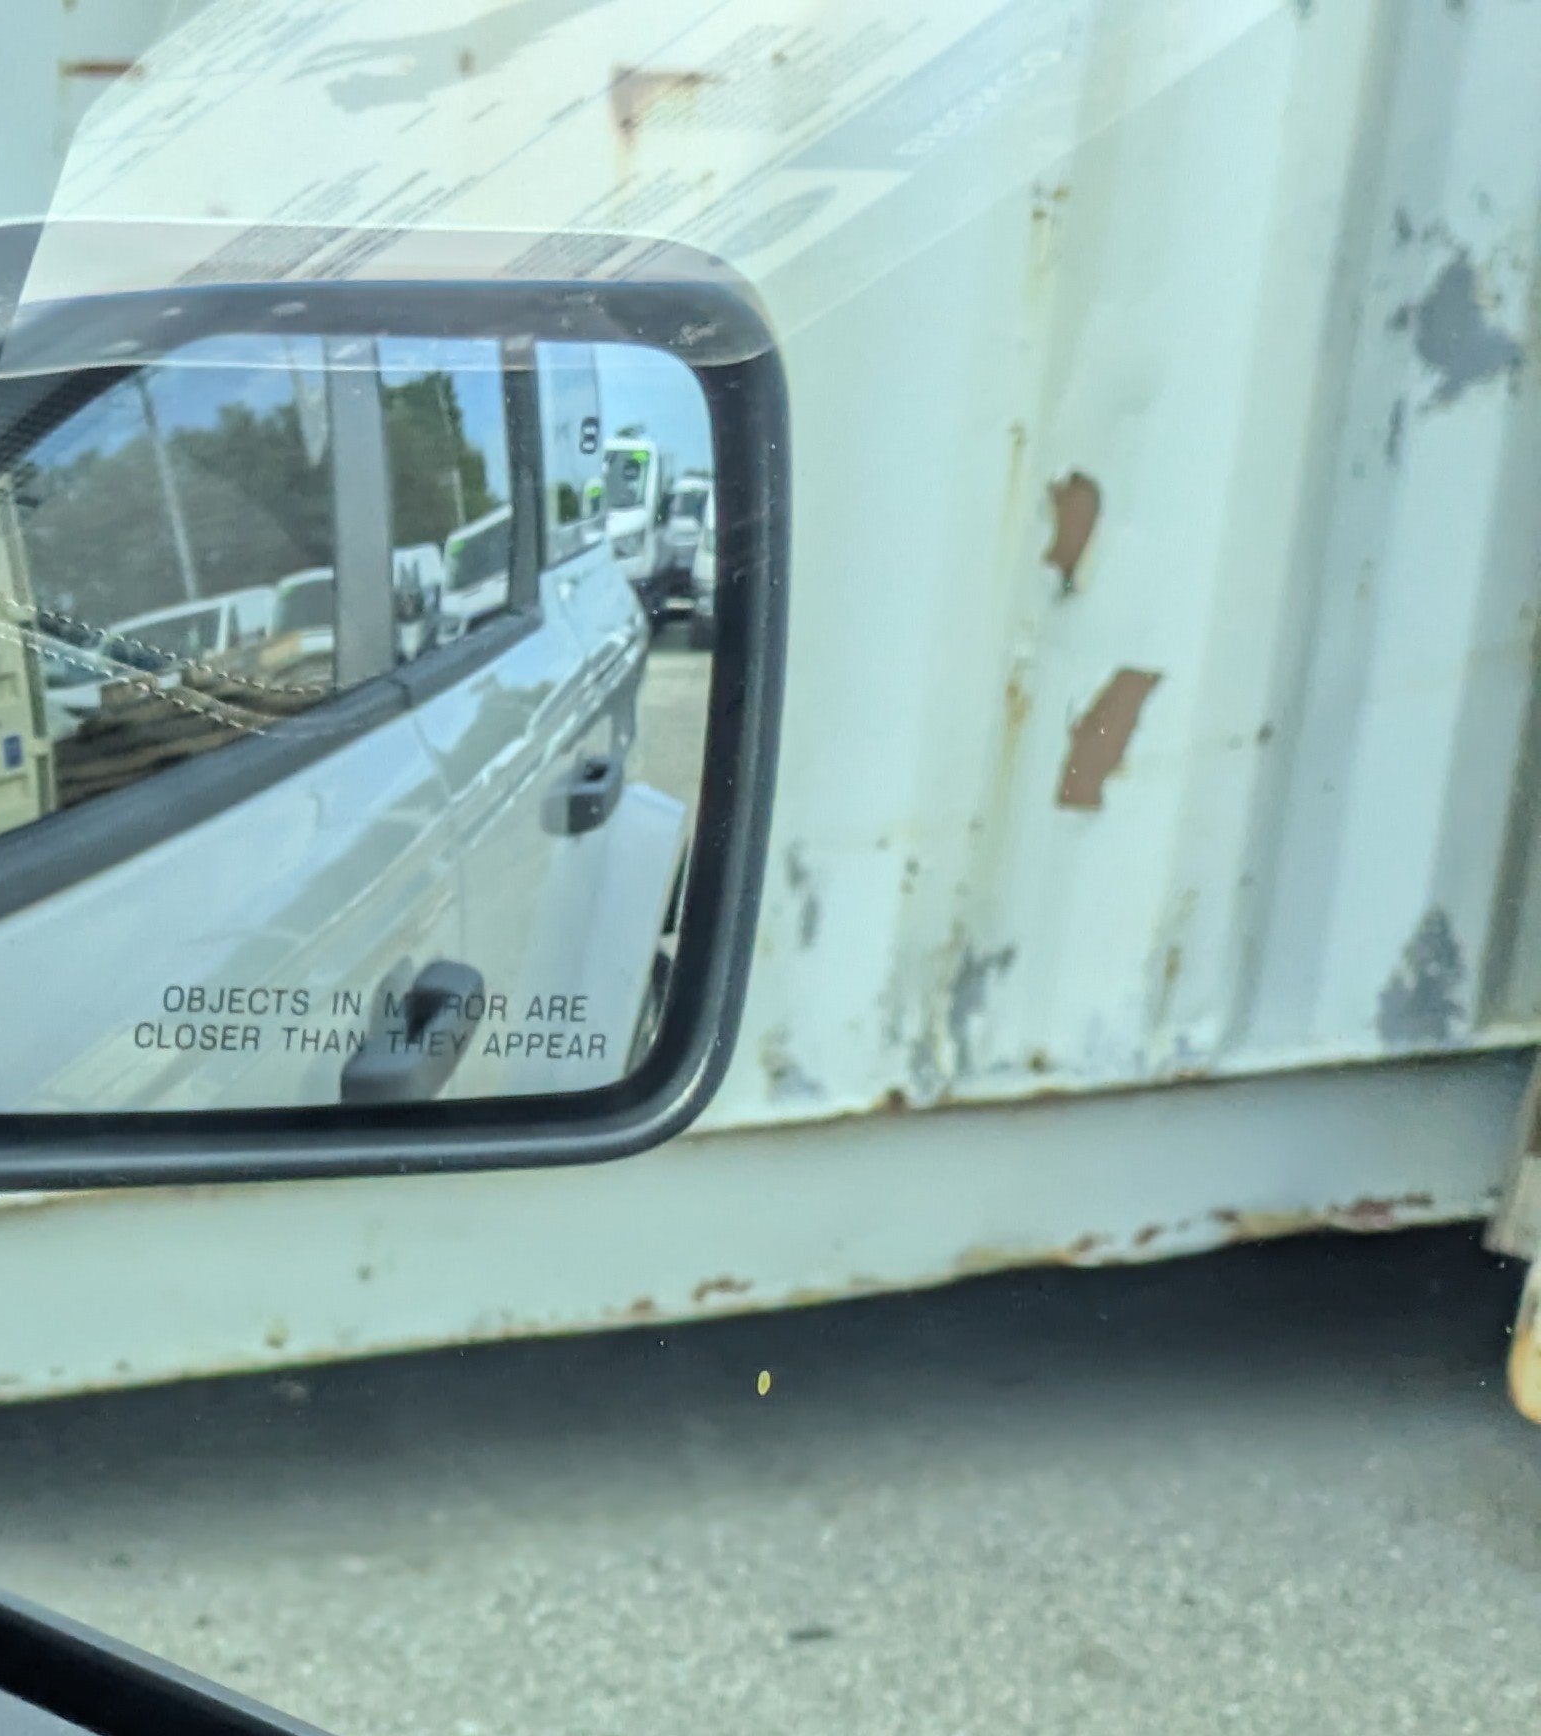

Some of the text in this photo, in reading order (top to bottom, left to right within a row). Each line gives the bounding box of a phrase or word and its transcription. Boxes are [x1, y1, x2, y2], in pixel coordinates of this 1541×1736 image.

[162, 985, 588, 1022] OBJECTS IN MROR ARE
[134, 1022, 606, 1059] CLOSER THAN THEY APPEAR
